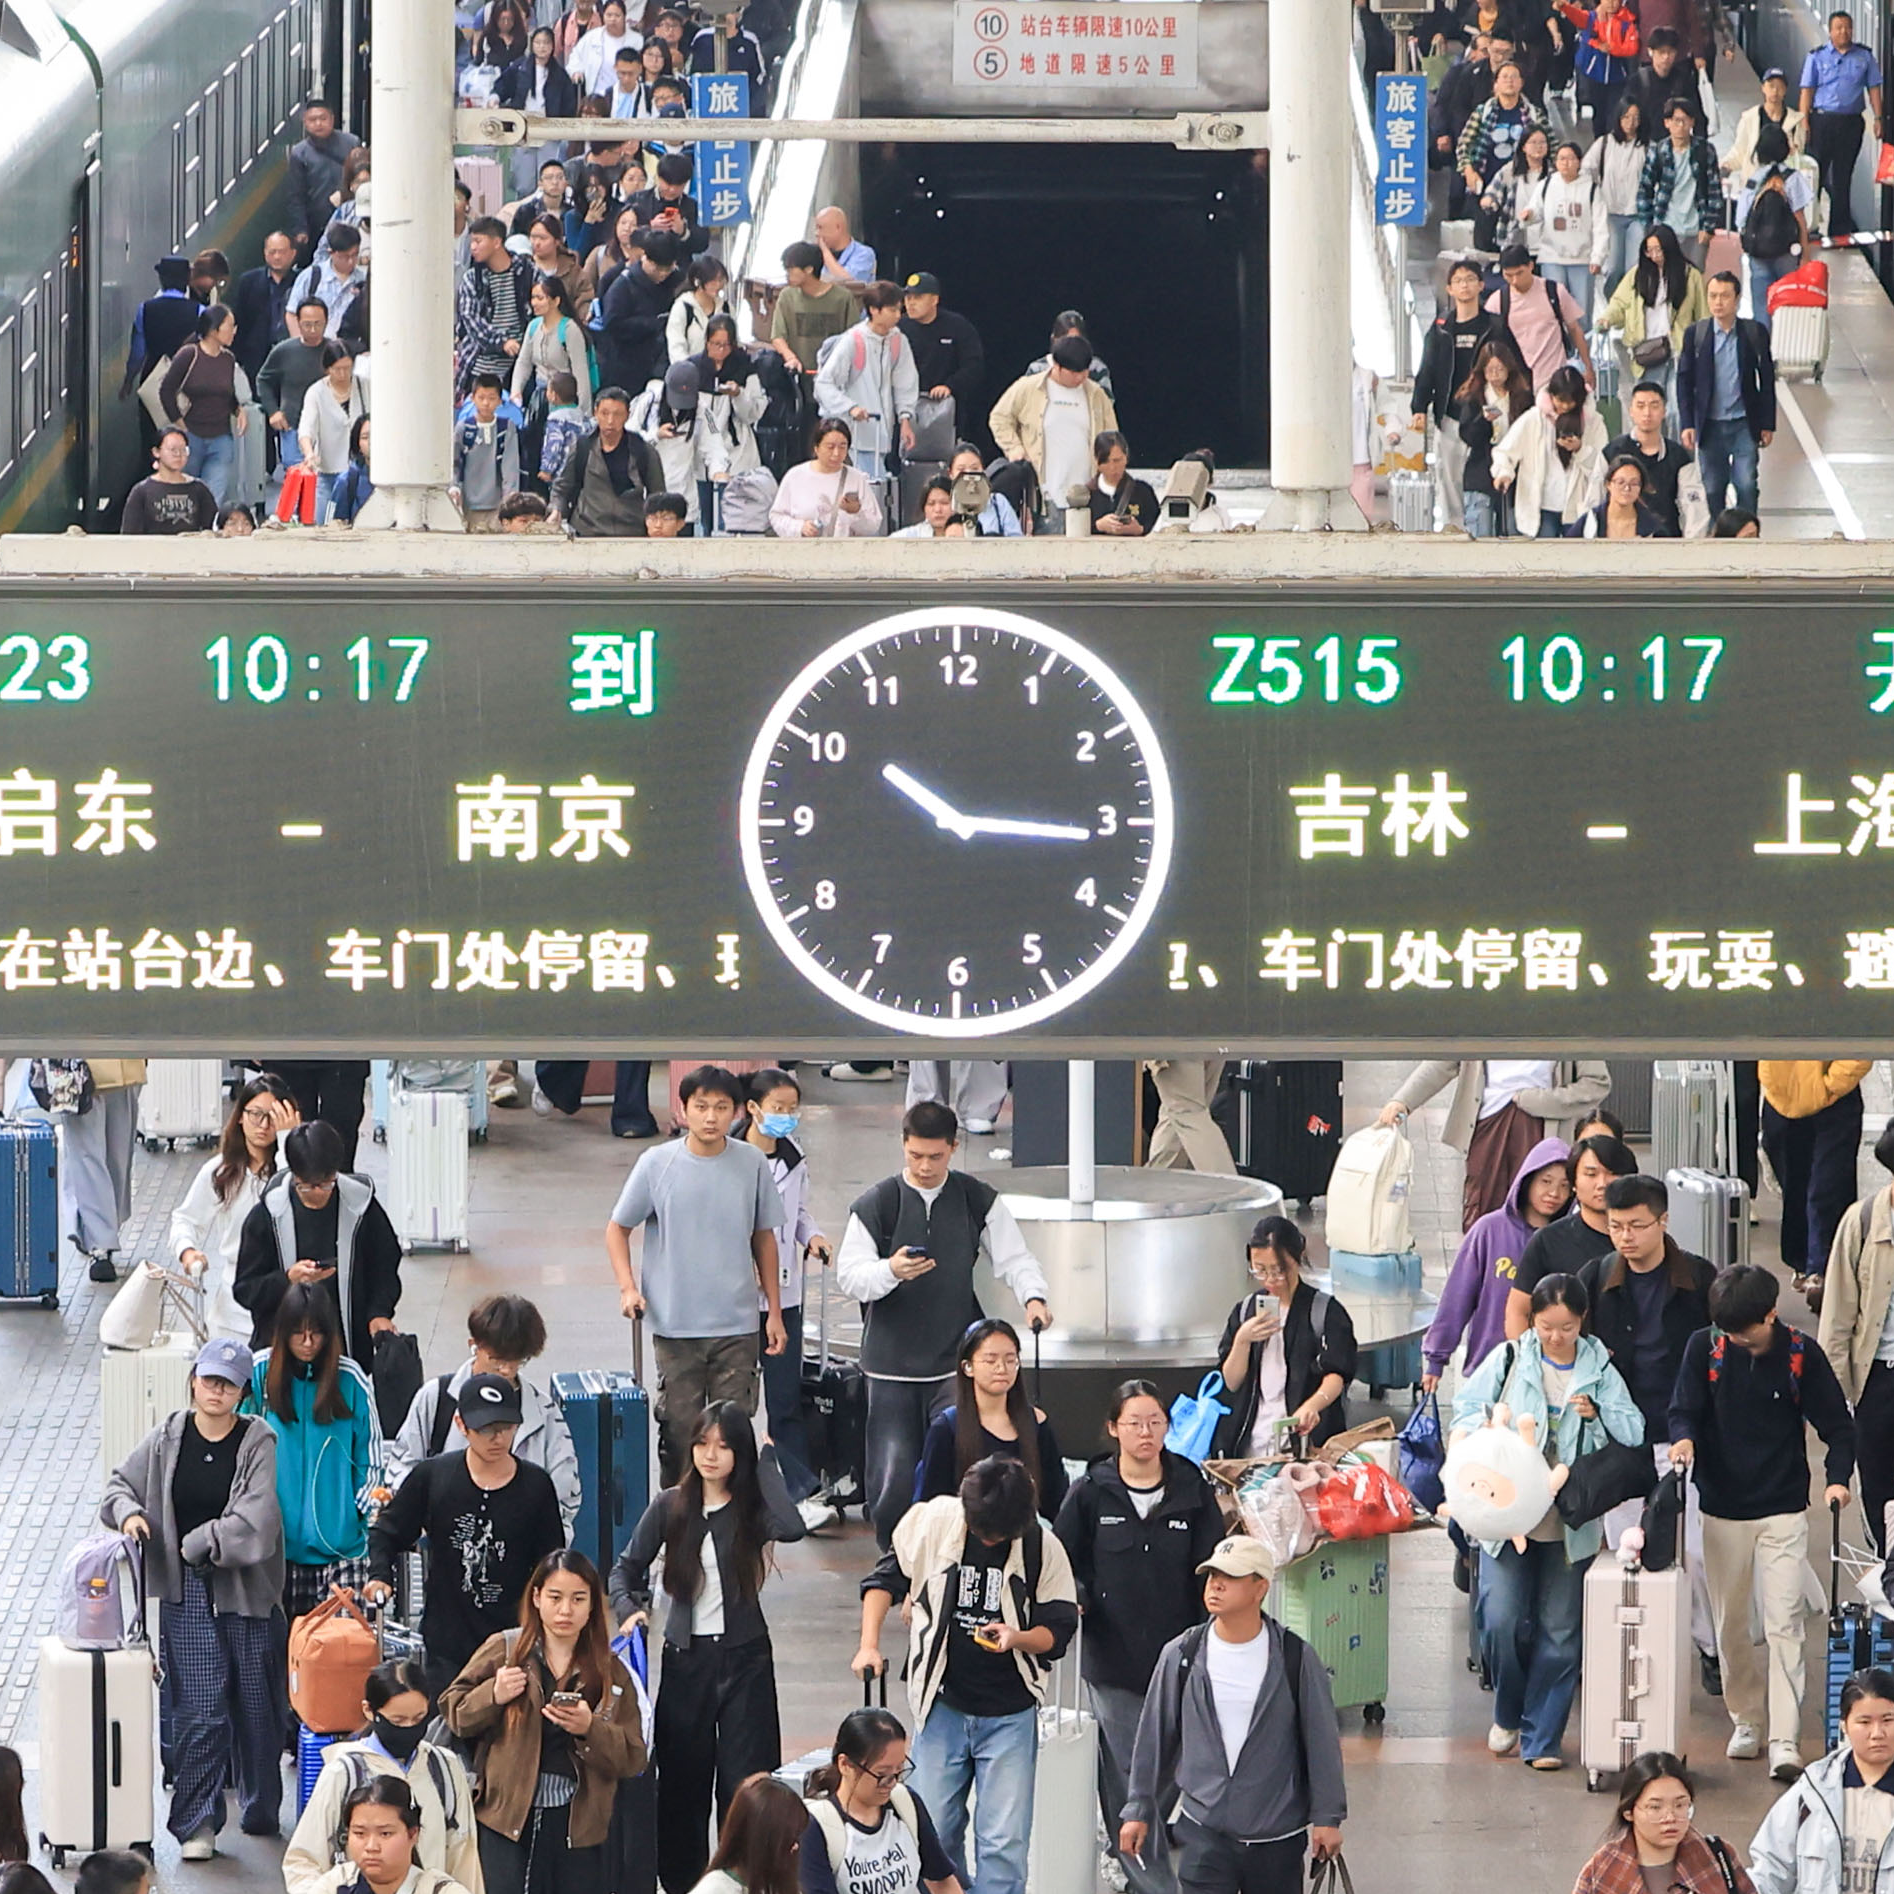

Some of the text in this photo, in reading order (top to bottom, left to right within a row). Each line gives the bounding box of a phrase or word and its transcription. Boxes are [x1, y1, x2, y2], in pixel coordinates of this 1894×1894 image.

[1021, 15, 1182, 39] 站台车辆限速10公里
[1020, 54, 1180, 77] 地道限速5公里
[708, 82, 742, 222] 旅止步
[1385, 82, 1417, 219] 旅客止步
[205, 634, 429, 704] 10:17
[570, 629, 656, 717] 到
[939, 655, 978, 685] 12
[1209, 634, 1401, 704] Z515
[1502, 634, 1724, 704] 10:17
[863, 676, 898, 705] 11
[1023, 676, 1039, 704] 1
[809, 732, 847, 761] 10
[1076, 731, 1097, 761] 2
[455, 773, 635, 862] 南京
[793, 805, 814, 836] 9
[1097, 805, 1118, 836] 3
[1287, 770, 1470, 860] 吉林
[814, 879, 837, 910] 8
[1074, 878, 1097, 908] 4
[871, 934, 893, 964] 7
[1022, 934, 1043, 964] 5
[947, 957, 969, 987] 6
